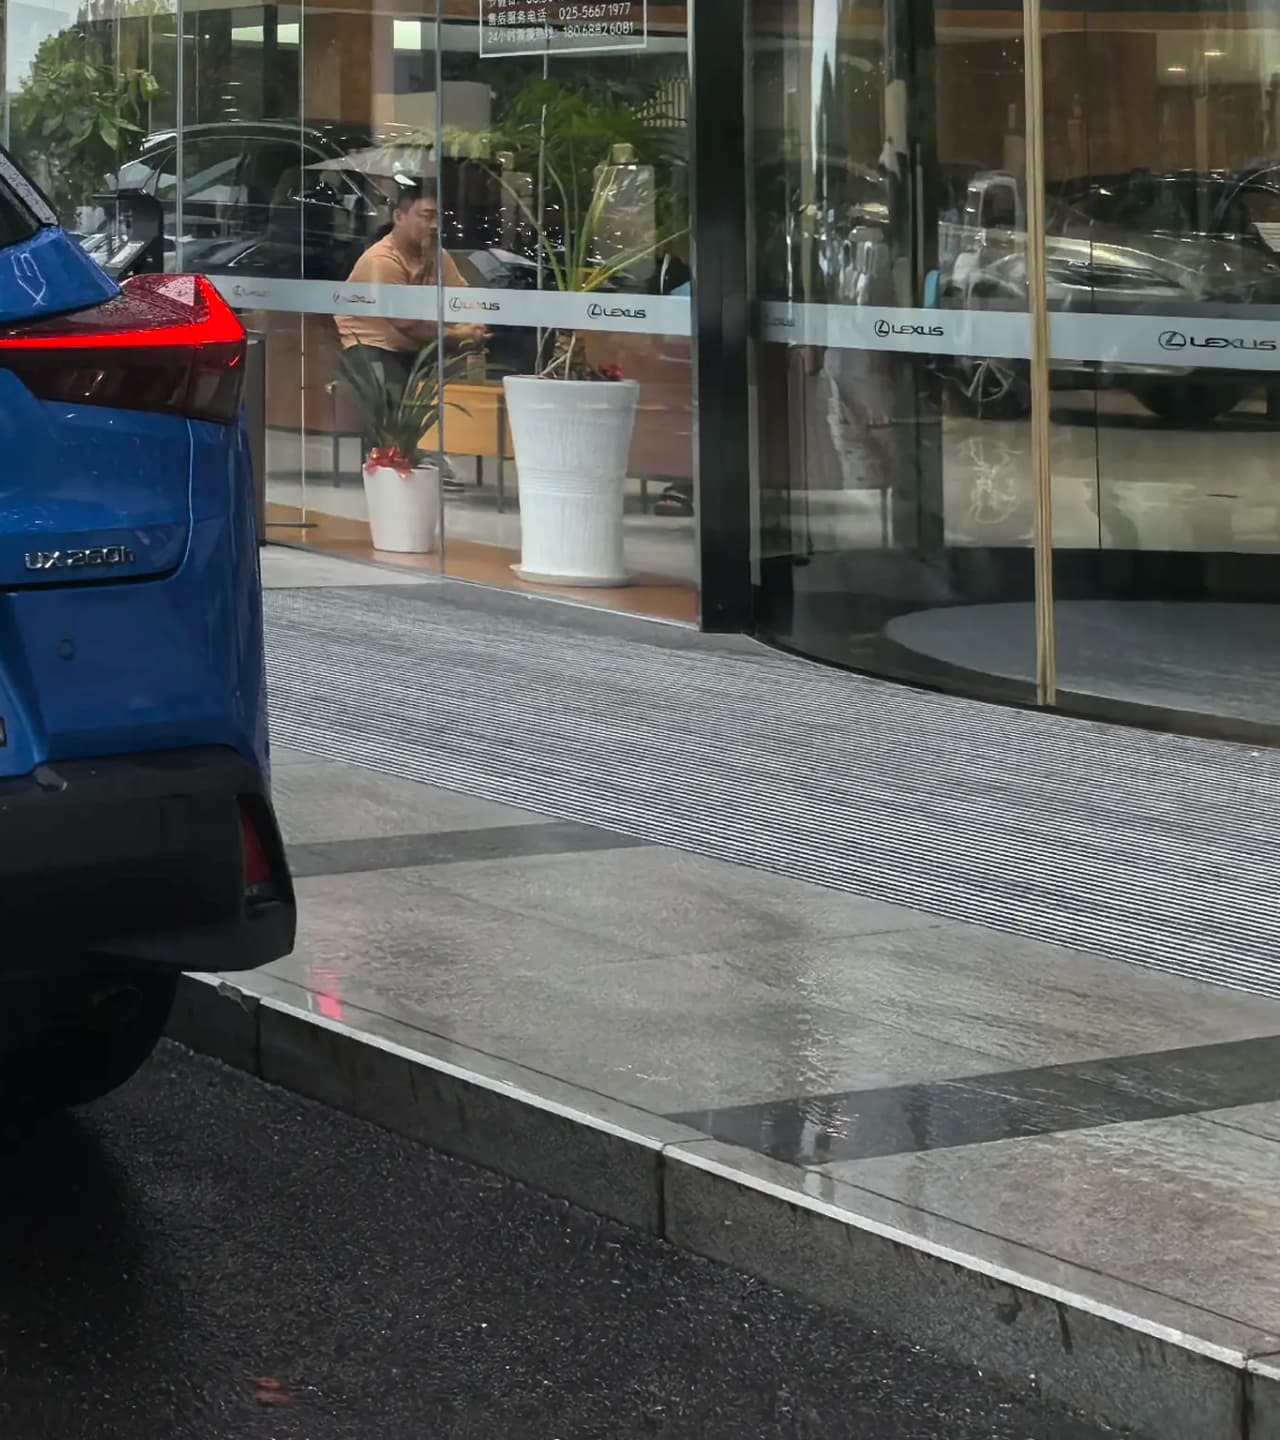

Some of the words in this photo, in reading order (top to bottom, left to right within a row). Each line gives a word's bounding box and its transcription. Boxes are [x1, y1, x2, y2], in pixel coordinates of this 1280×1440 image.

[558, 1, 631, 20] 025-56671977
[602, 309, 647, 319] LEXUS
[891, 324, 944, 337] LEXUS
[1190, 336, 1278, 351] LEXUS
[24, 551, 62, 569] UX
